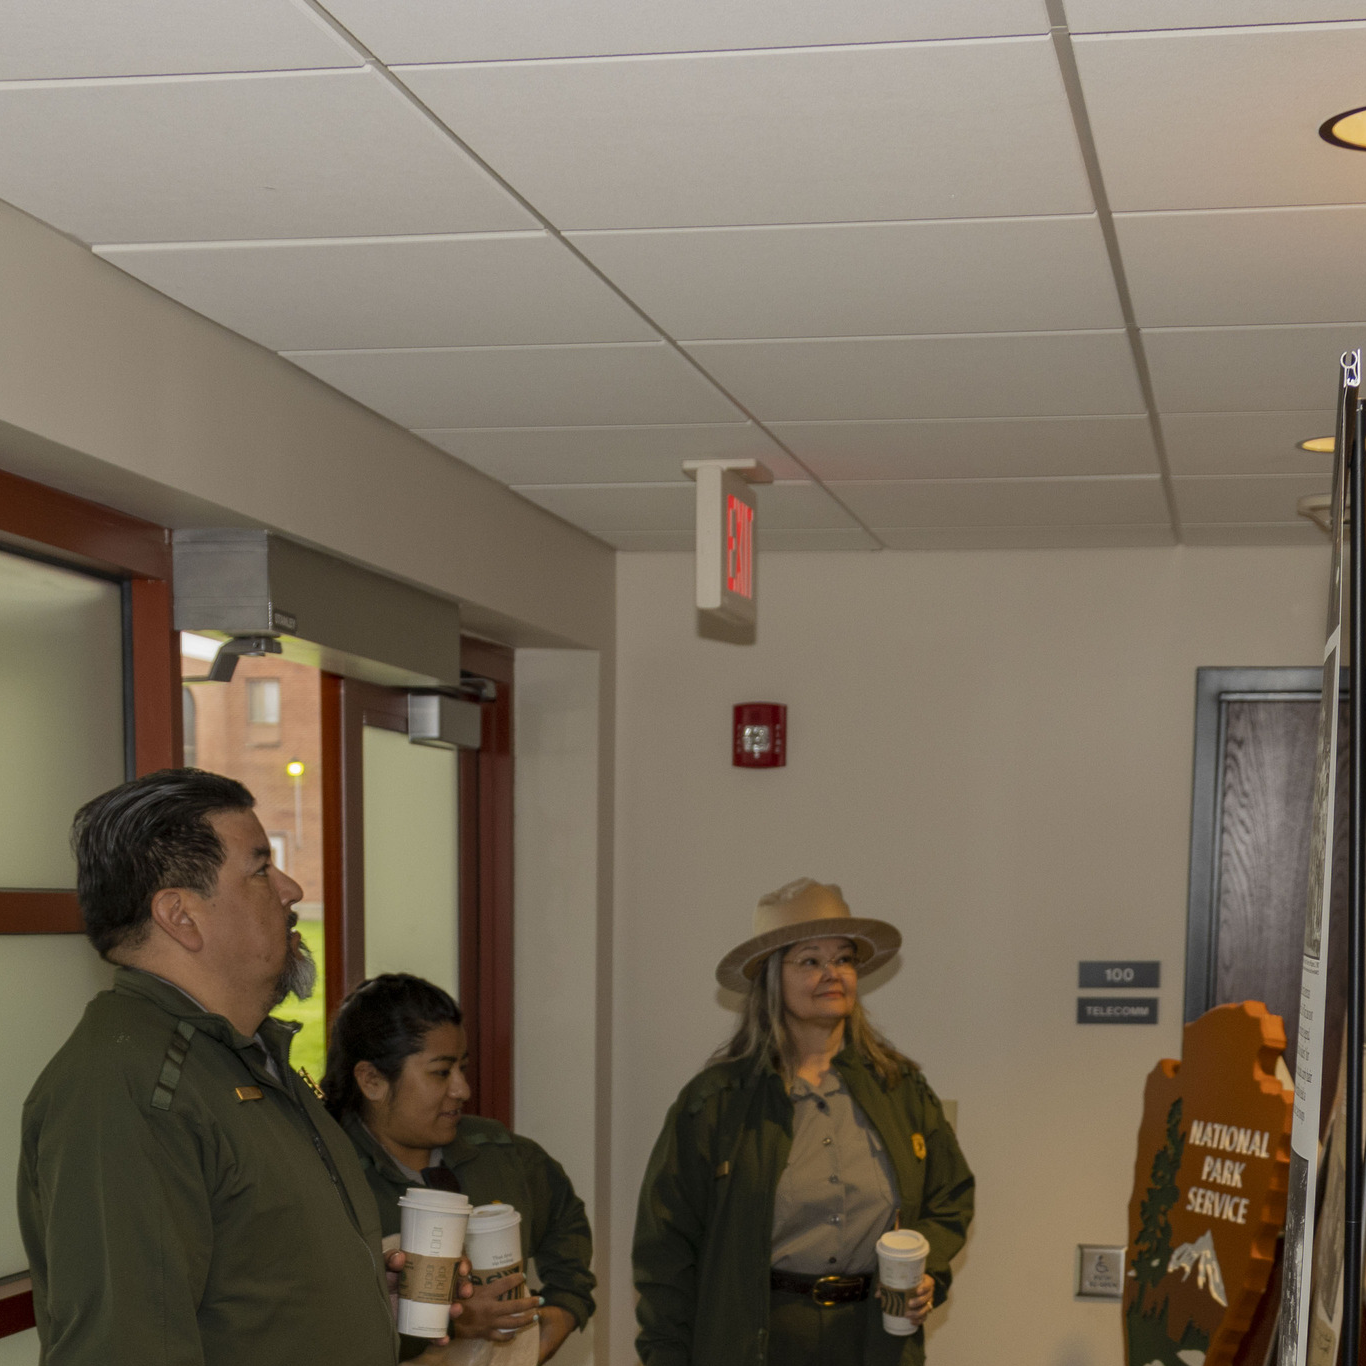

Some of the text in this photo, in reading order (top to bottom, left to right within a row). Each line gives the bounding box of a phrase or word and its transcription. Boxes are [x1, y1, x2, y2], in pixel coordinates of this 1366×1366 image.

[1104, 967, 1135, 982] 100
[1085, 1006, 1150, 1016] TELECOMM
[1188, 1119, 1270, 1159] NATIONAL
[1201, 1155, 1247, 1189] PARK
[1186, 1186, 1250, 1225] SERVICE
